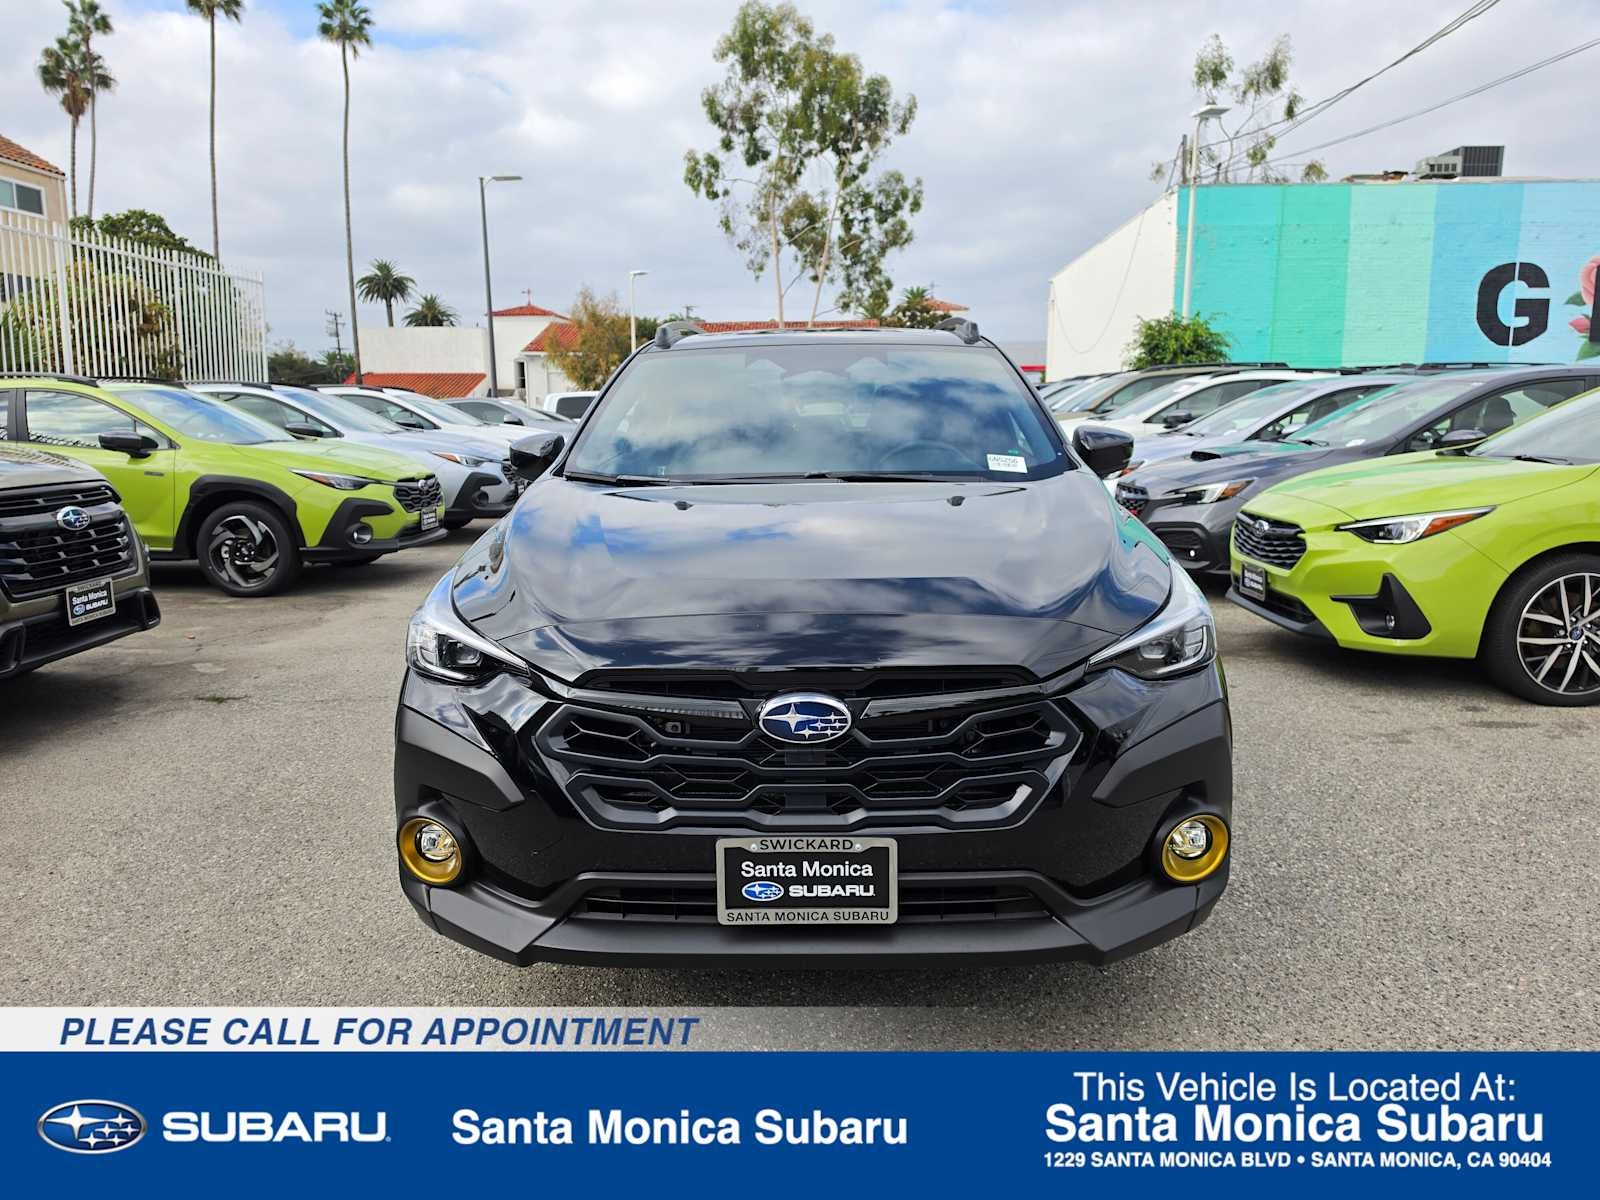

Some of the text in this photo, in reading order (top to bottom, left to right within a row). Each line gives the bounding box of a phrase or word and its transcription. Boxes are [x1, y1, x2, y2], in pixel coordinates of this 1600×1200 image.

[1477, 262, 1600, 346] G
[72, 596, 88, 605] Santa
[760, 838, 853, 850] SWICKARD
[741, 860, 874, 877] Santa Monica
[788, 884, 875, 897] SUBARU
[727, 911, 889, 922] SANTA MONICA SUBARU
